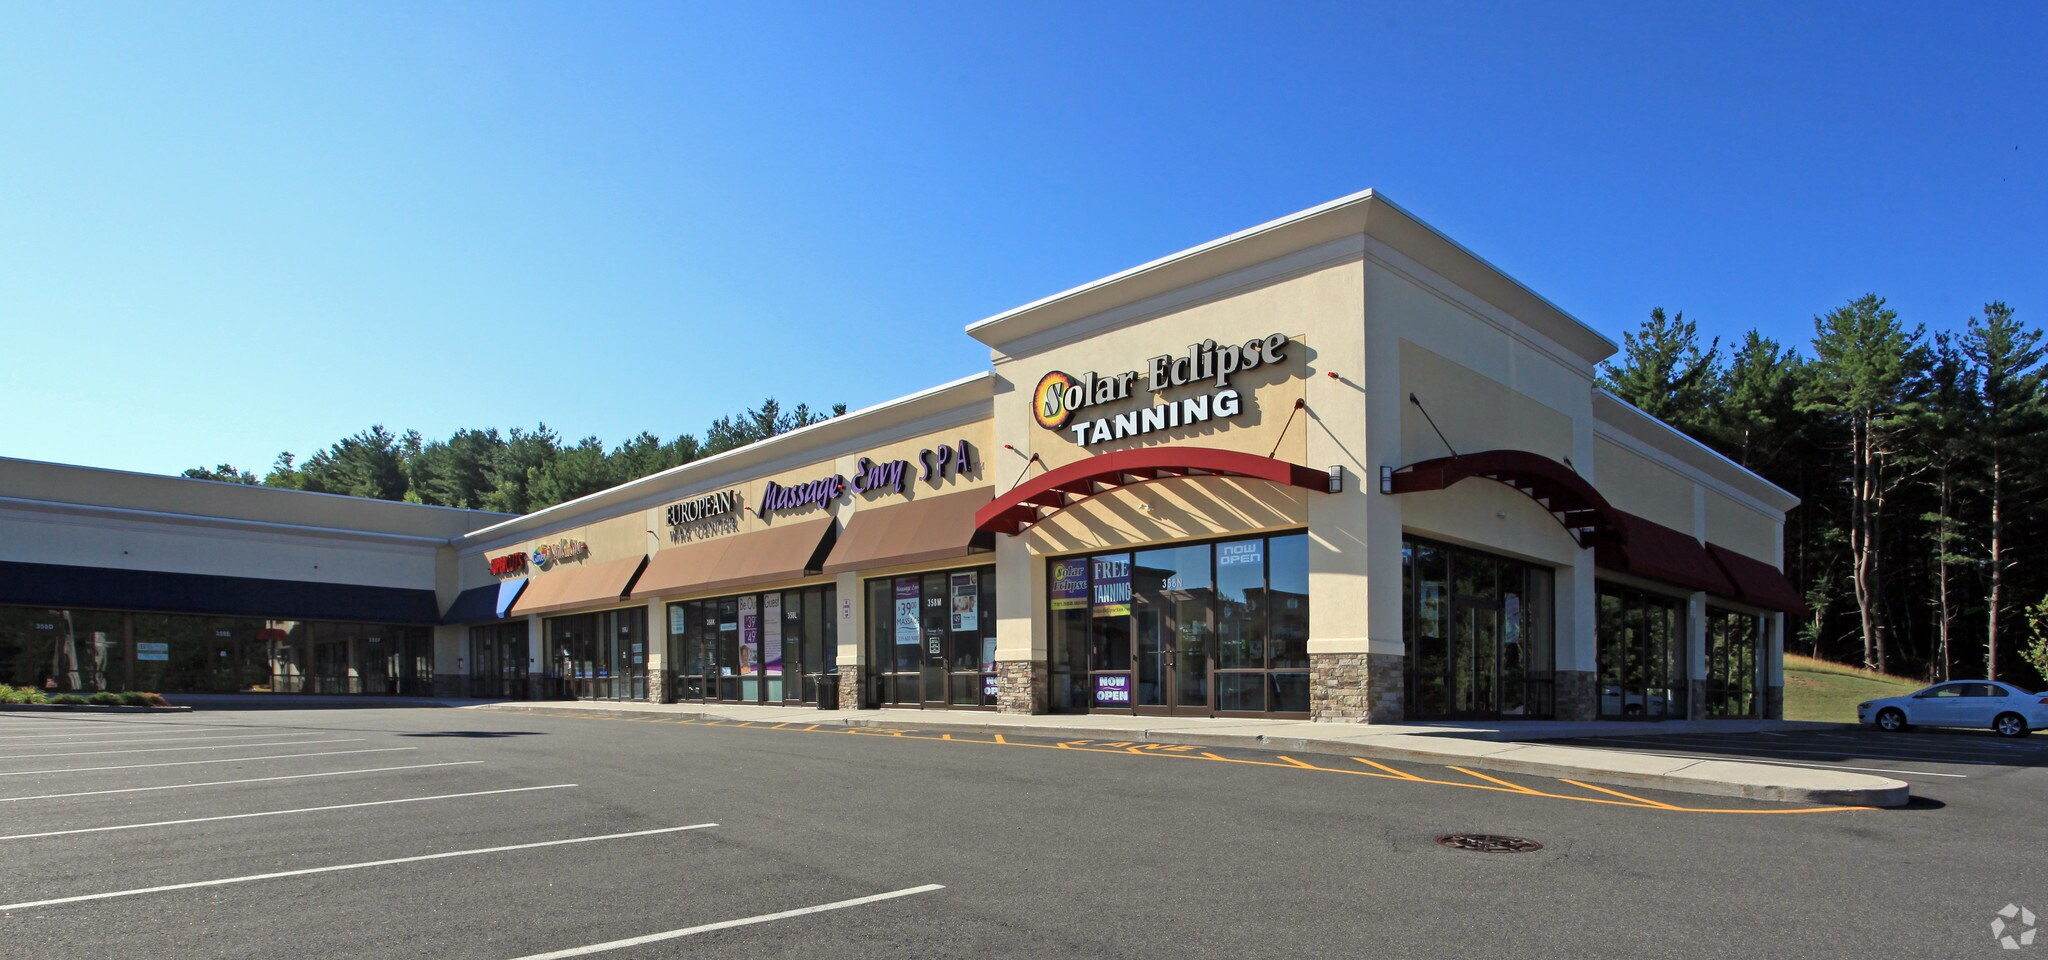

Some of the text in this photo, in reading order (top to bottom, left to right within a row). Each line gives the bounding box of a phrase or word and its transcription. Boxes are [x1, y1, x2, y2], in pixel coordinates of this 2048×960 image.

[1044, 333, 1289, 417] Solar Eclipse
[1071, 389, 1242, 447] TANNING
[757, 474, 843, 519] Massage
[851, 457, 908, 494] Envy
[919, 439, 972, 482] SPA
[665, 490, 734, 527] EUROPEAN
[669, 517, 739, 544] WAX CENTER
[1223, 543, 1256, 555] NOW
[1220, 553, 1261, 565] OPEN
[1056, 565, 1085, 579] Solar
[1094, 560, 1129, 580] FREE
[1053, 579, 1088, 593] Eclipse
[1162, 578, 1182, 589] 358N
[1094, 582, 1132, 604] TANNING
[927, 598, 942, 607] 358M
[1099, 676, 1126, 687] NOW
[1096, 690, 1129, 701] OPEN
